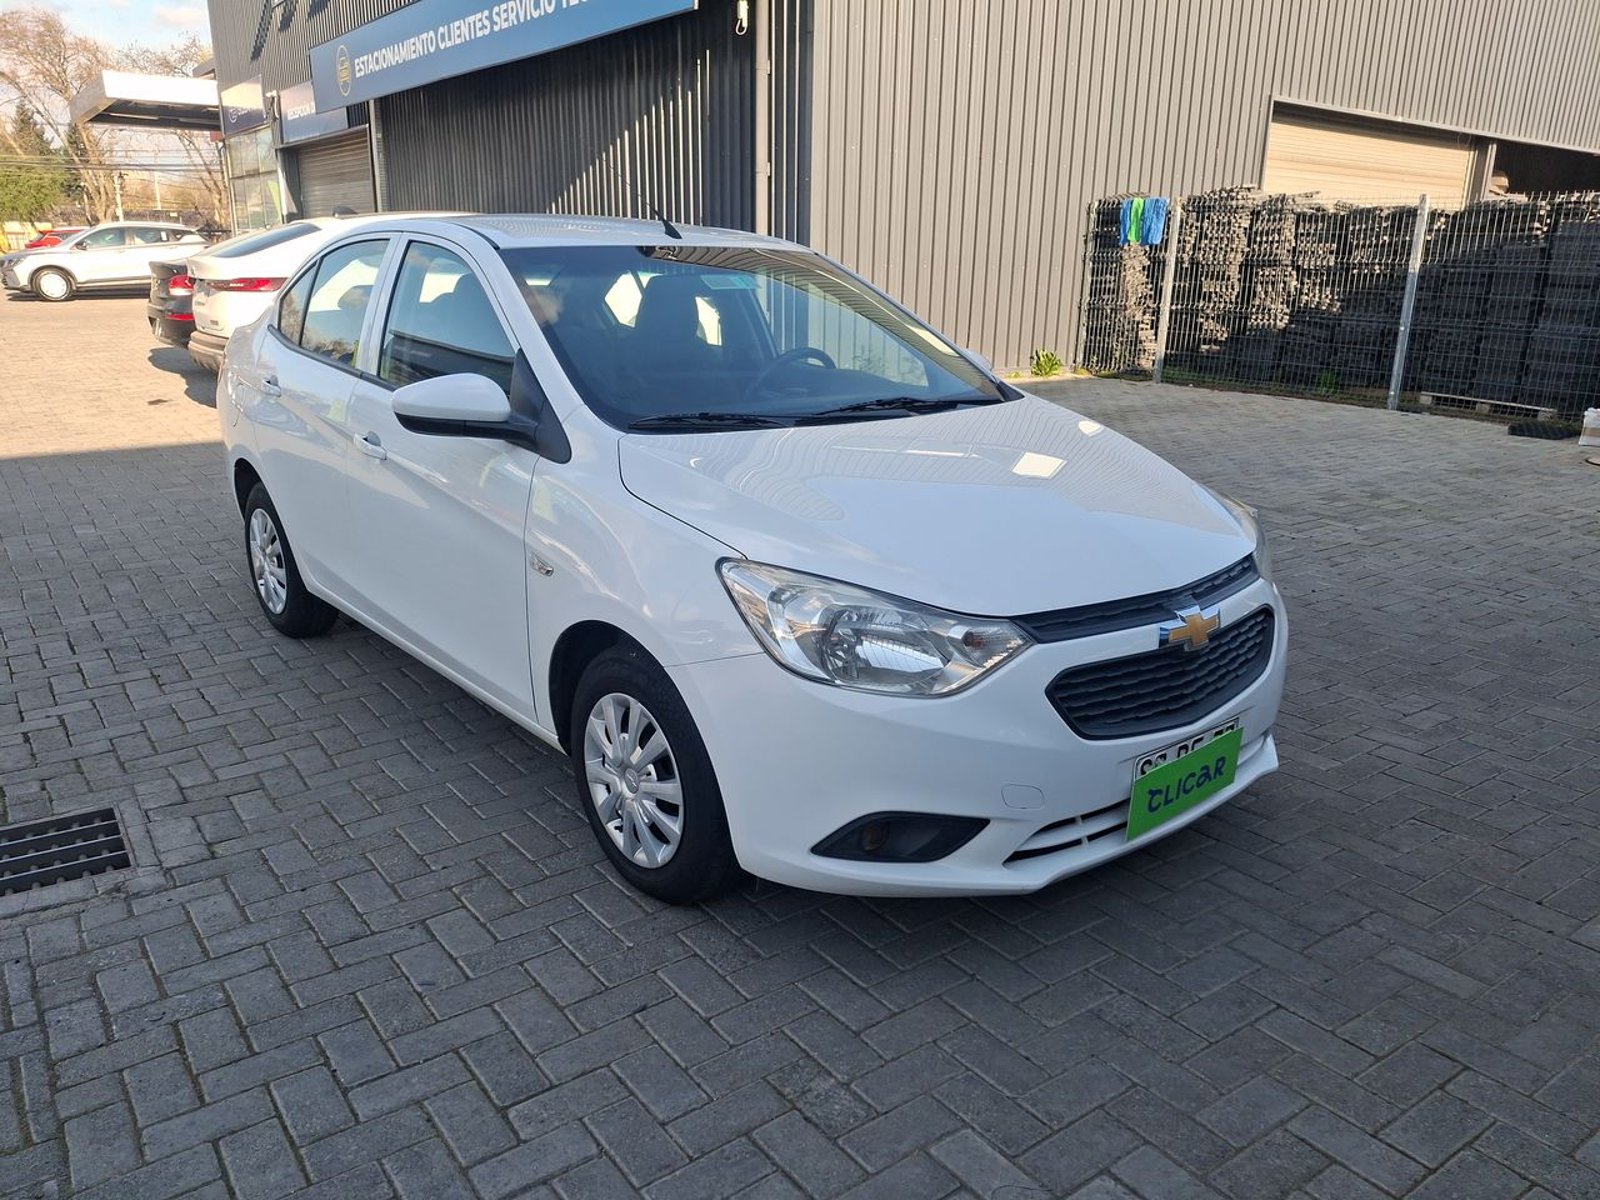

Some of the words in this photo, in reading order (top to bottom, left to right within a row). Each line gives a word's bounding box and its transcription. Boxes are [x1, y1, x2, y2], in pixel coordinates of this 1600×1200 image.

[354, 30, 436, 78] ESTACIONAMIENTO
[437, 10, 490, 50] CLIENTES
[493, 0, 556, 32] SERVICIO
